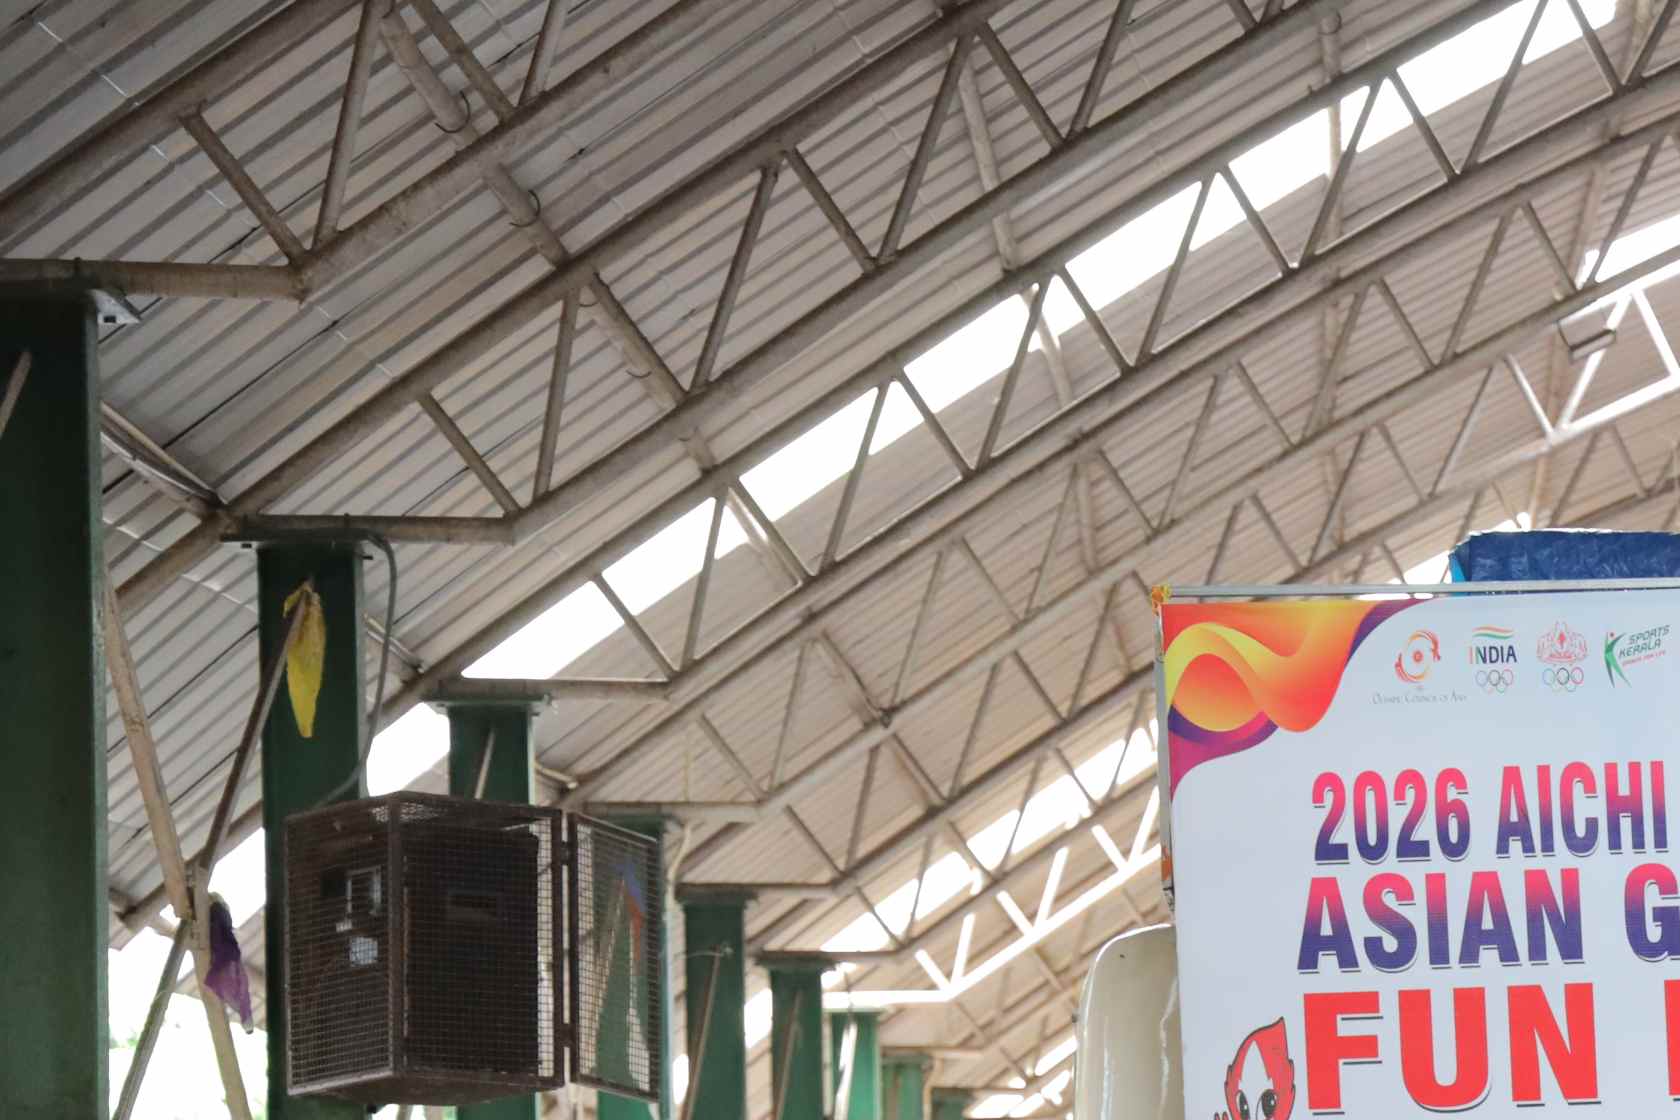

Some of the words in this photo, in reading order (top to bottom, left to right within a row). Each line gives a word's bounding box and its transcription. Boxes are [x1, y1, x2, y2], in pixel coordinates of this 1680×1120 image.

[1469, 645, 1517, 664] INDIA
[1618, 639, 1662, 658] KERALA
[1628, 624, 1671, 645] SPORTS
[1312, 767, 1471, 865] 2026
[1496, 760, 1669, 858] AICHI
[1297, 867, 1586, 974] ASIAN
[1303, 982, 1602, 1115] FUN
